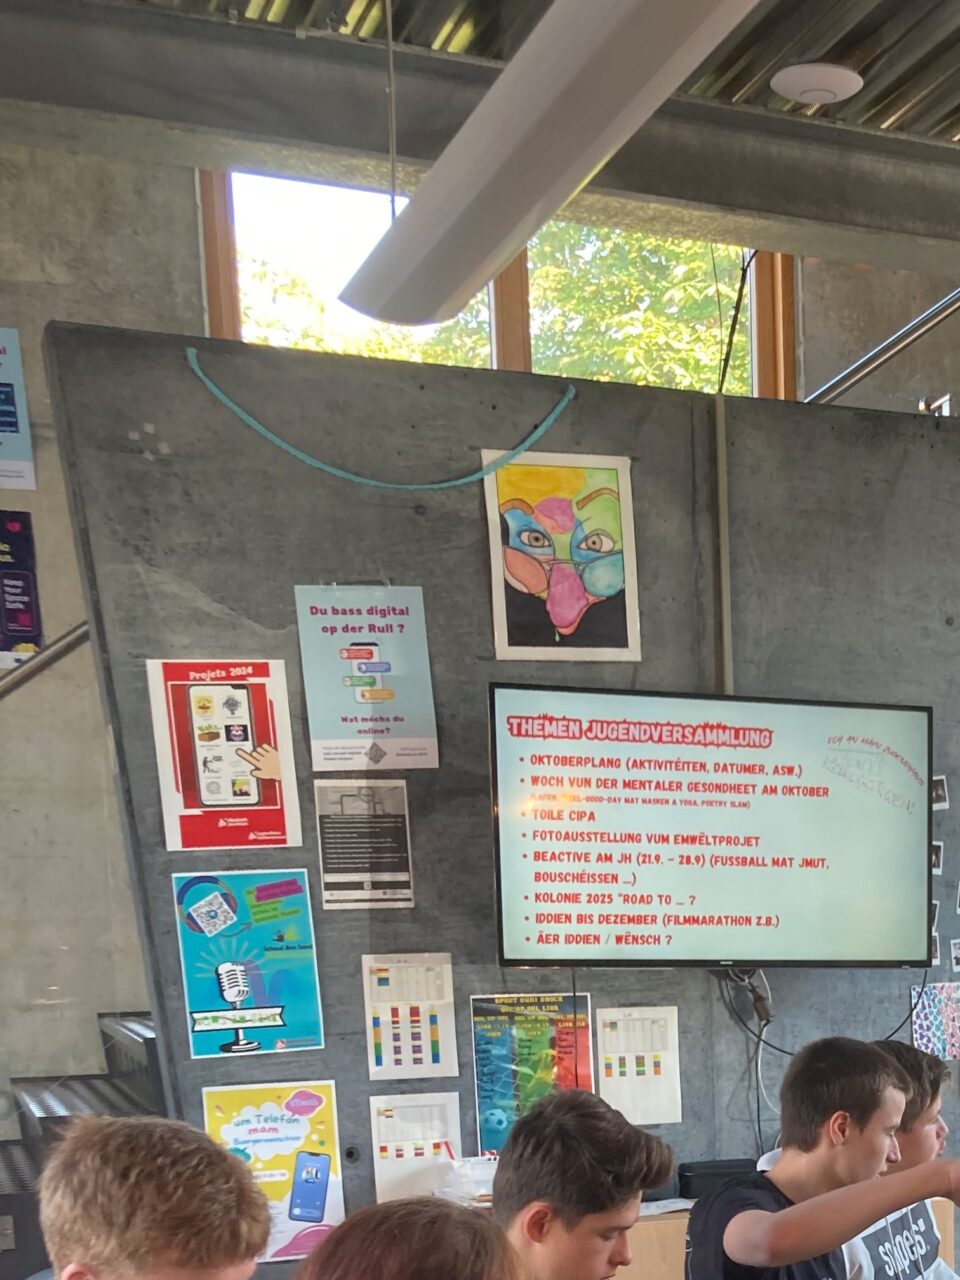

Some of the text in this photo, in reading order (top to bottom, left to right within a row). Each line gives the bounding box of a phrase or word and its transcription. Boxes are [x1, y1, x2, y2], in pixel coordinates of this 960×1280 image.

[309, 605, 409, 618] Du bass digital
[321, 624, 337, 635] op
[342, 624, 364, 633] der
[368, 624, 393, 633] Rull
[189, 666, 253, 682] Projets 2024
[508, 715, 773, 748] THEMEN JUGENDVERSAMMLUNG
[530, 754, 803, 778] OKTOBERPLANG (AKTIVITÉITEN, DATUMER, ASW.)
[530, 776, 829, 797] WOCH VUN DER MENTALER GESONDHEET AM OKTOBER
[532, 809, 596, 822] TOILE CIPA
[532, 830, 760, 847] FOTOAUSSTELLUNG VUM EMWËLTPROJET
[533, 851, 591, 863] BEACTIVE
[596, 853, 613, 864] AM
[617, 853, 632, 864] JH
[636, 853, 664, 867] (21.9.
[678, 854, 706, 867] 28.9)
[710, 854, 768, 869] (FUSSBALL
[771, 857, 795, 868] MAT
[534, 869, 619, 884] BOUSCHÉISSEN
[534, 892, 582, 904] KOLONIE
[586, 893, 613, 904] 2025
[657, 895, 672, 905] TO
[688, 895, 696, 905] ?
[535, 913, 780, 928] IDDIEN BIS DEZEMBER (FILMMARATHON Z.B.)
[536, 930, 560, 945] ÄER
[564, 934, 600, 945] IDDIEN
[615, 931, 661, 945] WËNSCH
[665, 935, 672, 945] ?
